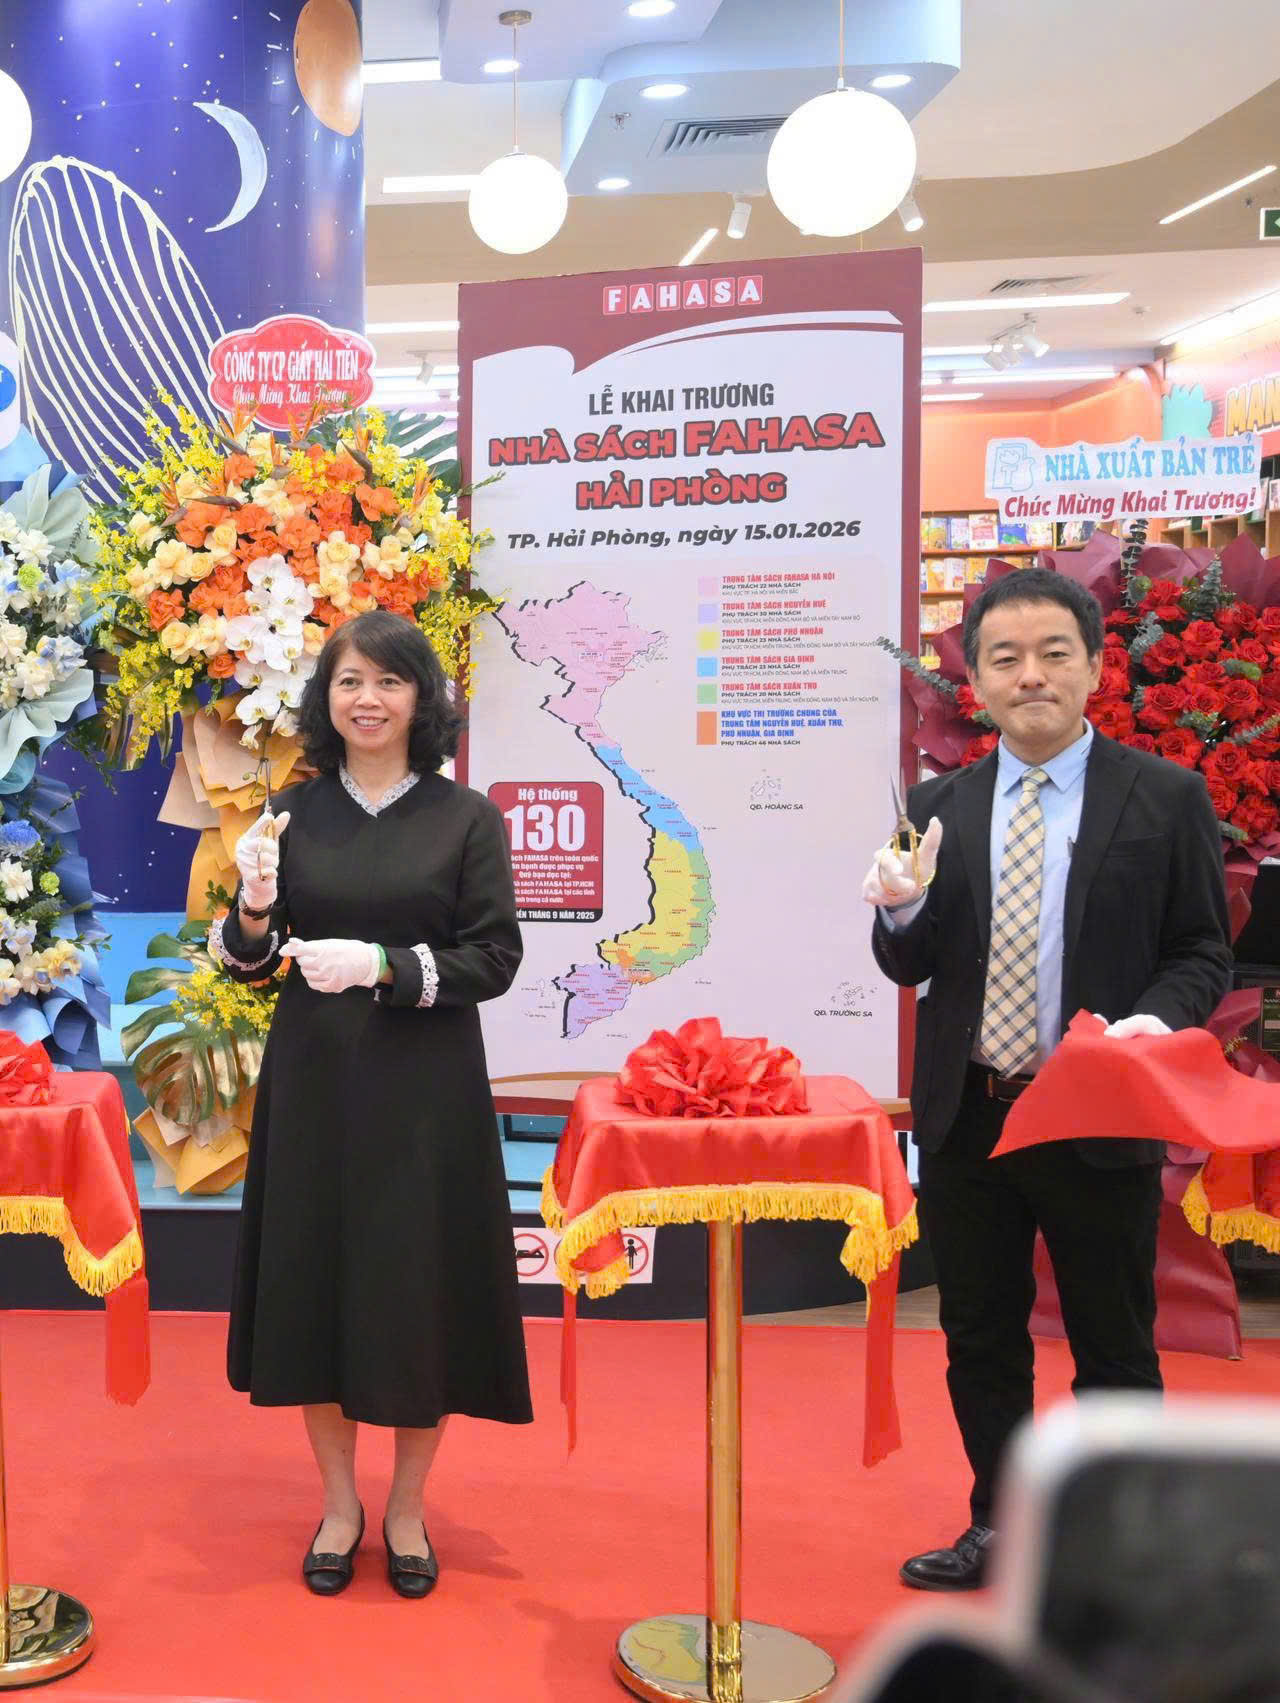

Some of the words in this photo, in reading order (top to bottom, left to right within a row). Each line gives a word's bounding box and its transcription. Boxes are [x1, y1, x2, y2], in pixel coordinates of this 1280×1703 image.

[607, 277, 762, 312] FAHASA
[224, 345, 255, 382] CÔNG
[257, 352, 273, 381] TY
[273, 351, 286, 381] CP
[288, 340, 314, 382] GIẤY
[315, 339, 333, 381] HẢI
[335, 341, 359, 380] TIẾN
[287, 384, 310, 405] Khai
[588, 383, 614, 416] LỄ
[621, 388, 674, 413] KHAI
[681, 382, 775, 410] TRƯƠNG
[488, 428, 570, 467] NHÀ
[573, 424, 676, 461] SÁCH
[683, 412, 885, 457] FAHASA
[1044, 444, 1091, 482] NHÀ
[1096, 437, 1156, 480] XUẤT
[1161, 435, 1208, 477] BẢN
[1212, 435, 1255, 474] TRẺ
[576, 470, 643, 510] HẢI
[650, 467, 788, 508] PHÒNG
[1004, 492, 1051, 518] Chúc
[1057, 491, 1115, 520] Mừng
[1120, 489, 1168, 513] Khai
[1173, 487, 1256, 511] Trương!
[508, 533, 541, 550] TP.
[547, 528, 586, 548] Hải
[591, 529, 671, 548] Phòng,
[677, 526, 738, 545] ngày
[744, 520, 861, 540] 15.01.2026
[518, 788, 535, 803] Hệ
[538, 787, 578, 802] thống
[504, 804, 585, 851] 130
[528, 909, 550, 919] THÁNG
[559, 910, 575, 919] NĂM
[576, 911, 594, 919] 2025
